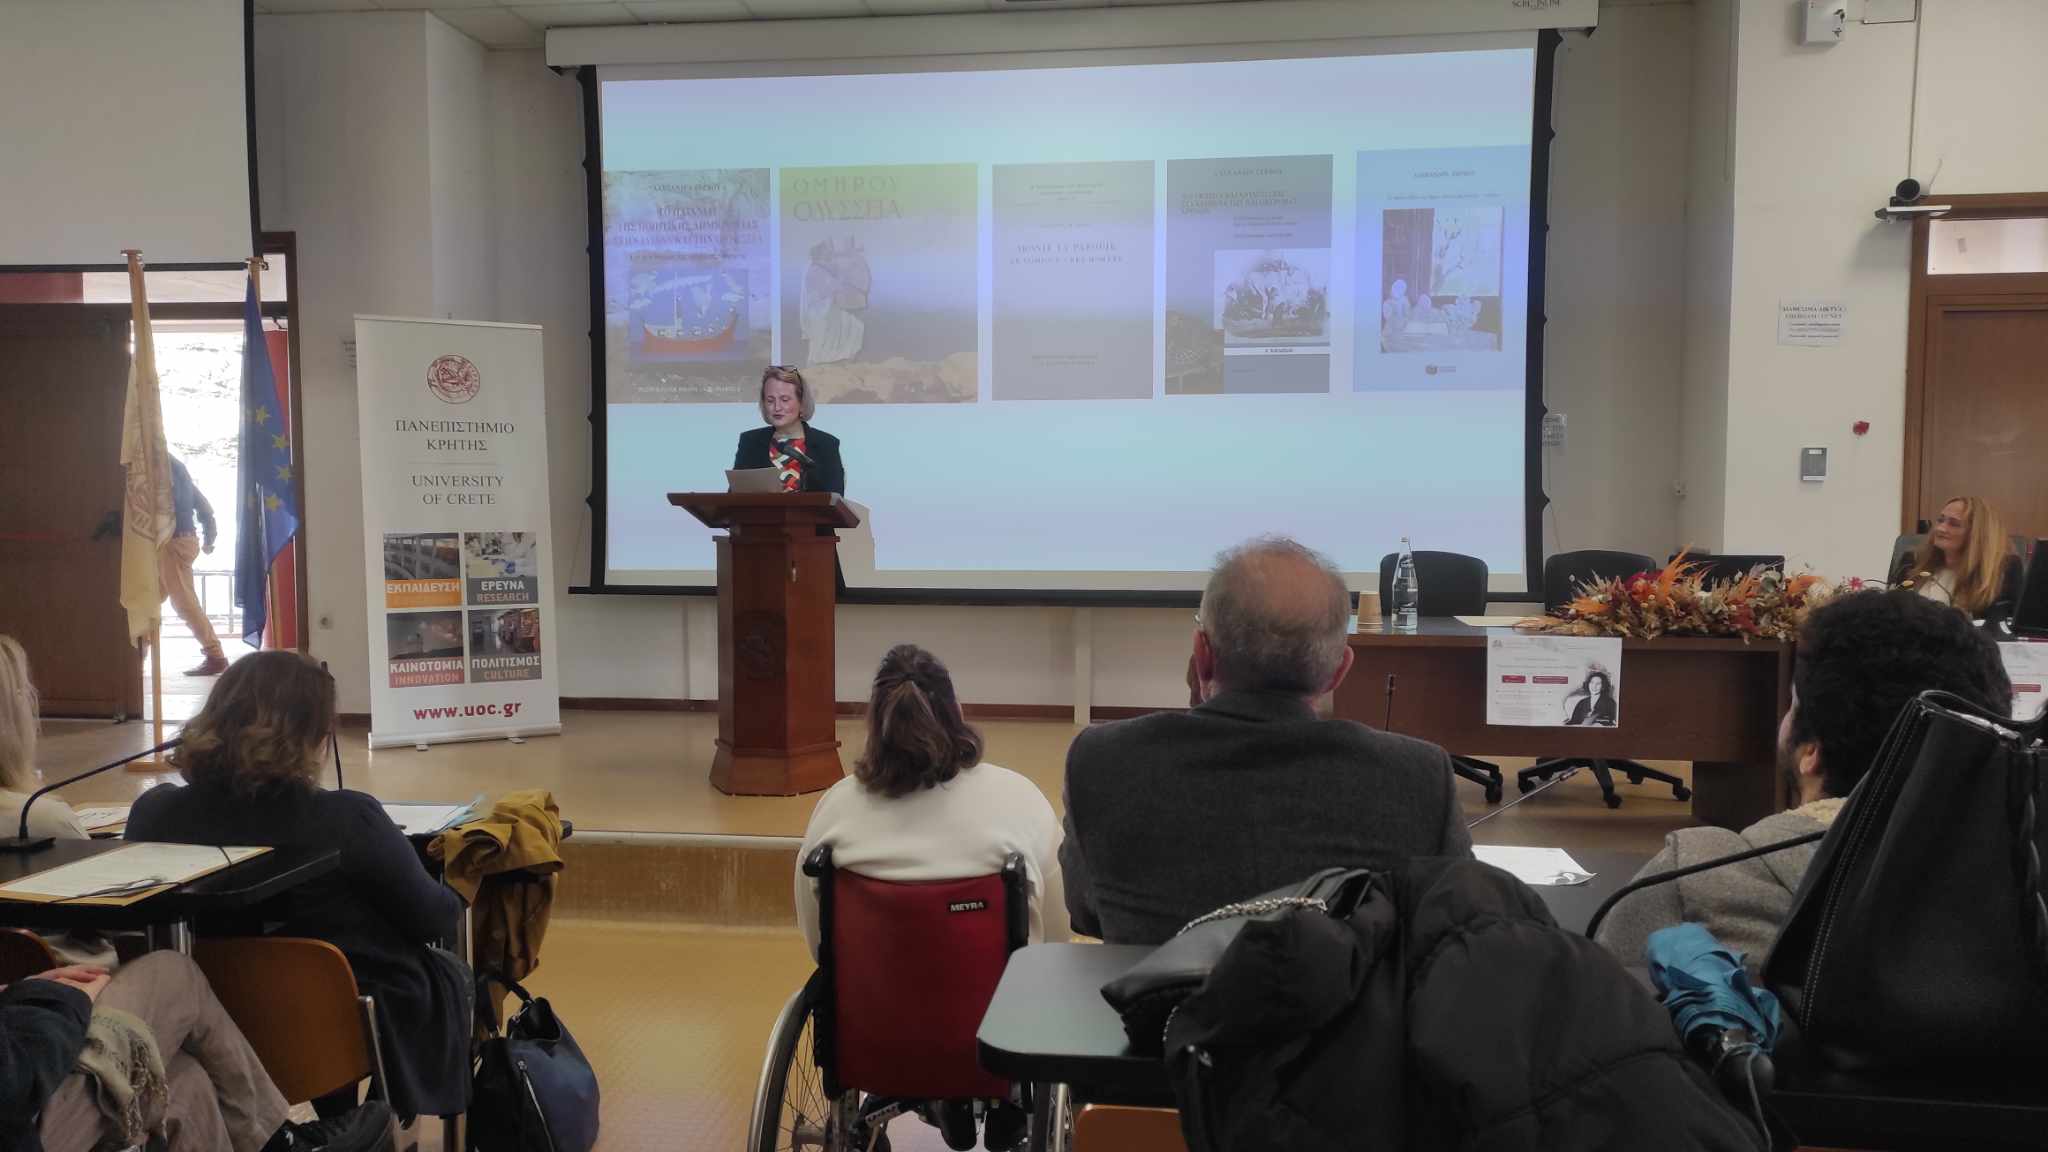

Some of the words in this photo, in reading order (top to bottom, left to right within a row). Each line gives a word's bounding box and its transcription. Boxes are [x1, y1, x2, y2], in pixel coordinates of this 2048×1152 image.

[395, 419, 515, 434] ΠΑΝΕΠΙΣΤΗΜΙΟ
[427, 439, 488, 451] ΚΡΗΤΗΣ
[412, 474, 504, 487] UNIVERSITY
[422, 493, 443, 505] OF
[446, 493, 496, 505] CRETE
[386, 582, 460, 594] ΕΚΠΑΙΔΕΥΣΗ
[480, 580, 525, 591] ΕΡΕΥΝΑ
[476, 592, 529, 602] RESEARCH
[390, 660, 464, 673] ΚΑΙΝΟΤΟΜΙΑ
[471, 656, 540, 669] ΠΟΛΙΤΙΣΜΟΣ
[484, 668, 529, 680] CULTURE
[413, 701, 522, 720] www.uoc.gr
[950, 901, 985, 911] MEYRA
